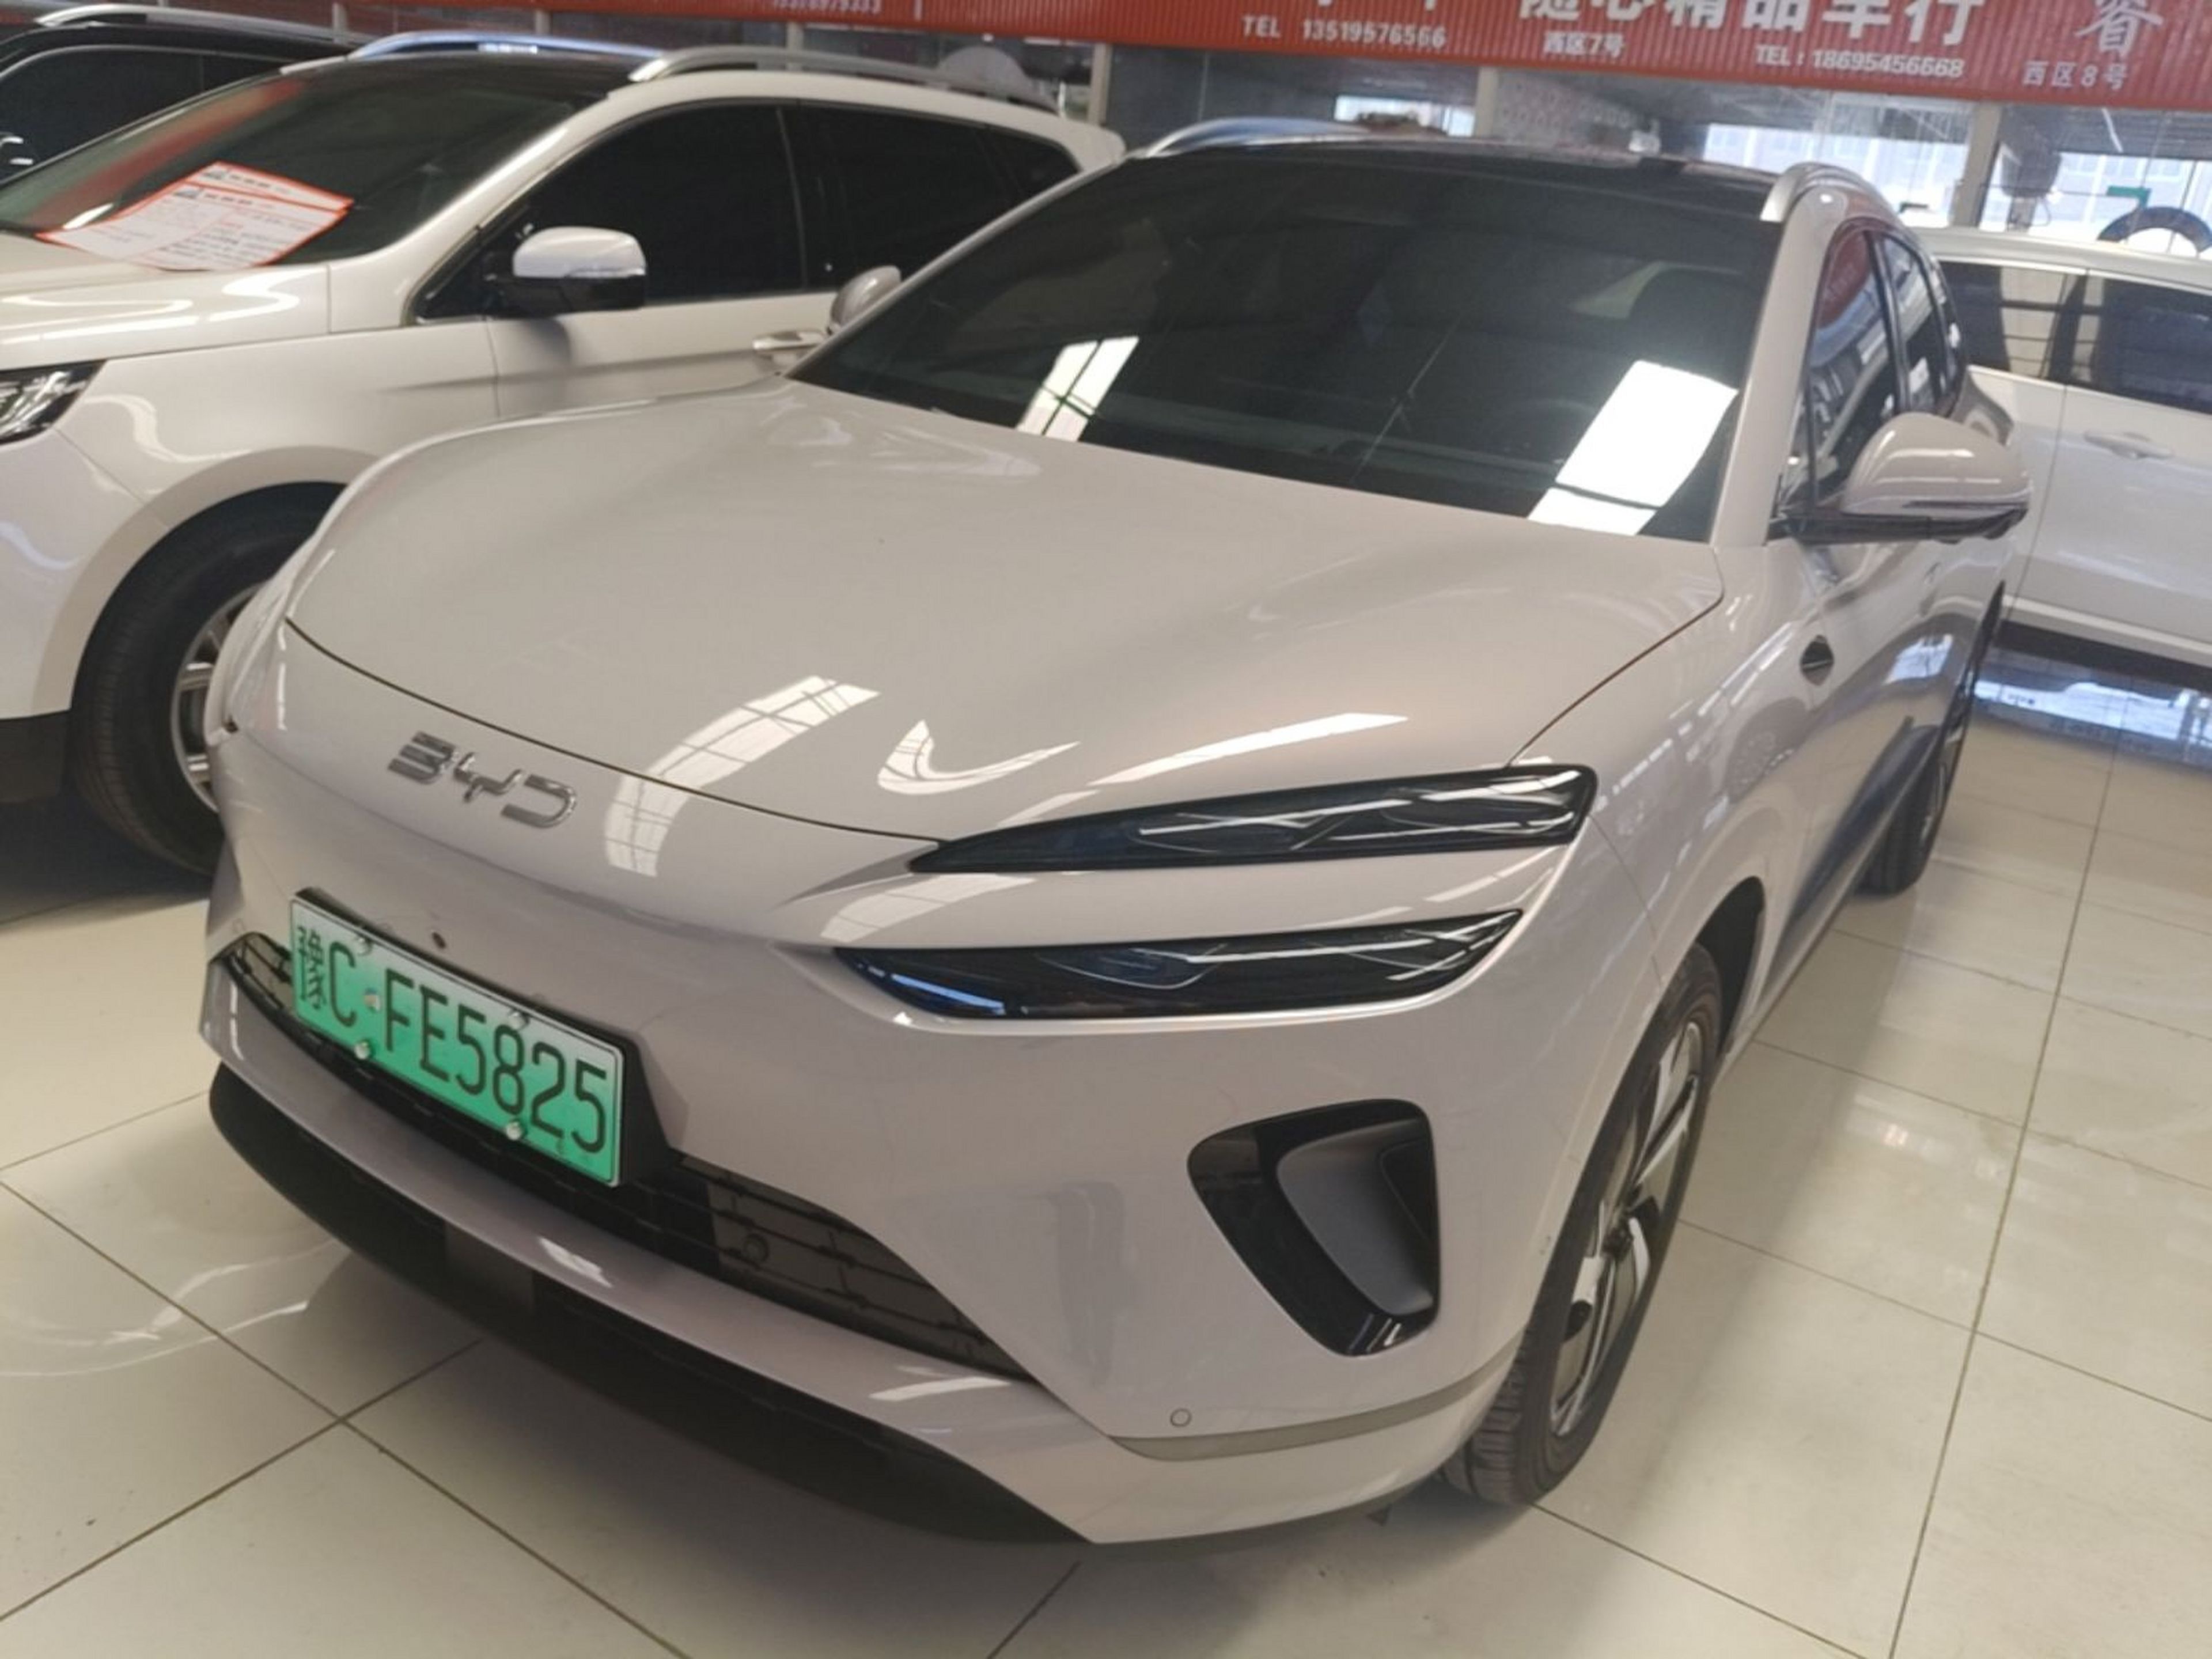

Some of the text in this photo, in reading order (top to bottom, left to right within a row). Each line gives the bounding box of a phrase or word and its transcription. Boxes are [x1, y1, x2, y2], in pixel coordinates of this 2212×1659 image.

[1242, 14, 1281, 39] TEL
[2022, 60, 2128, 90] 西区8号
[388, 730, 577, 828] BYD
